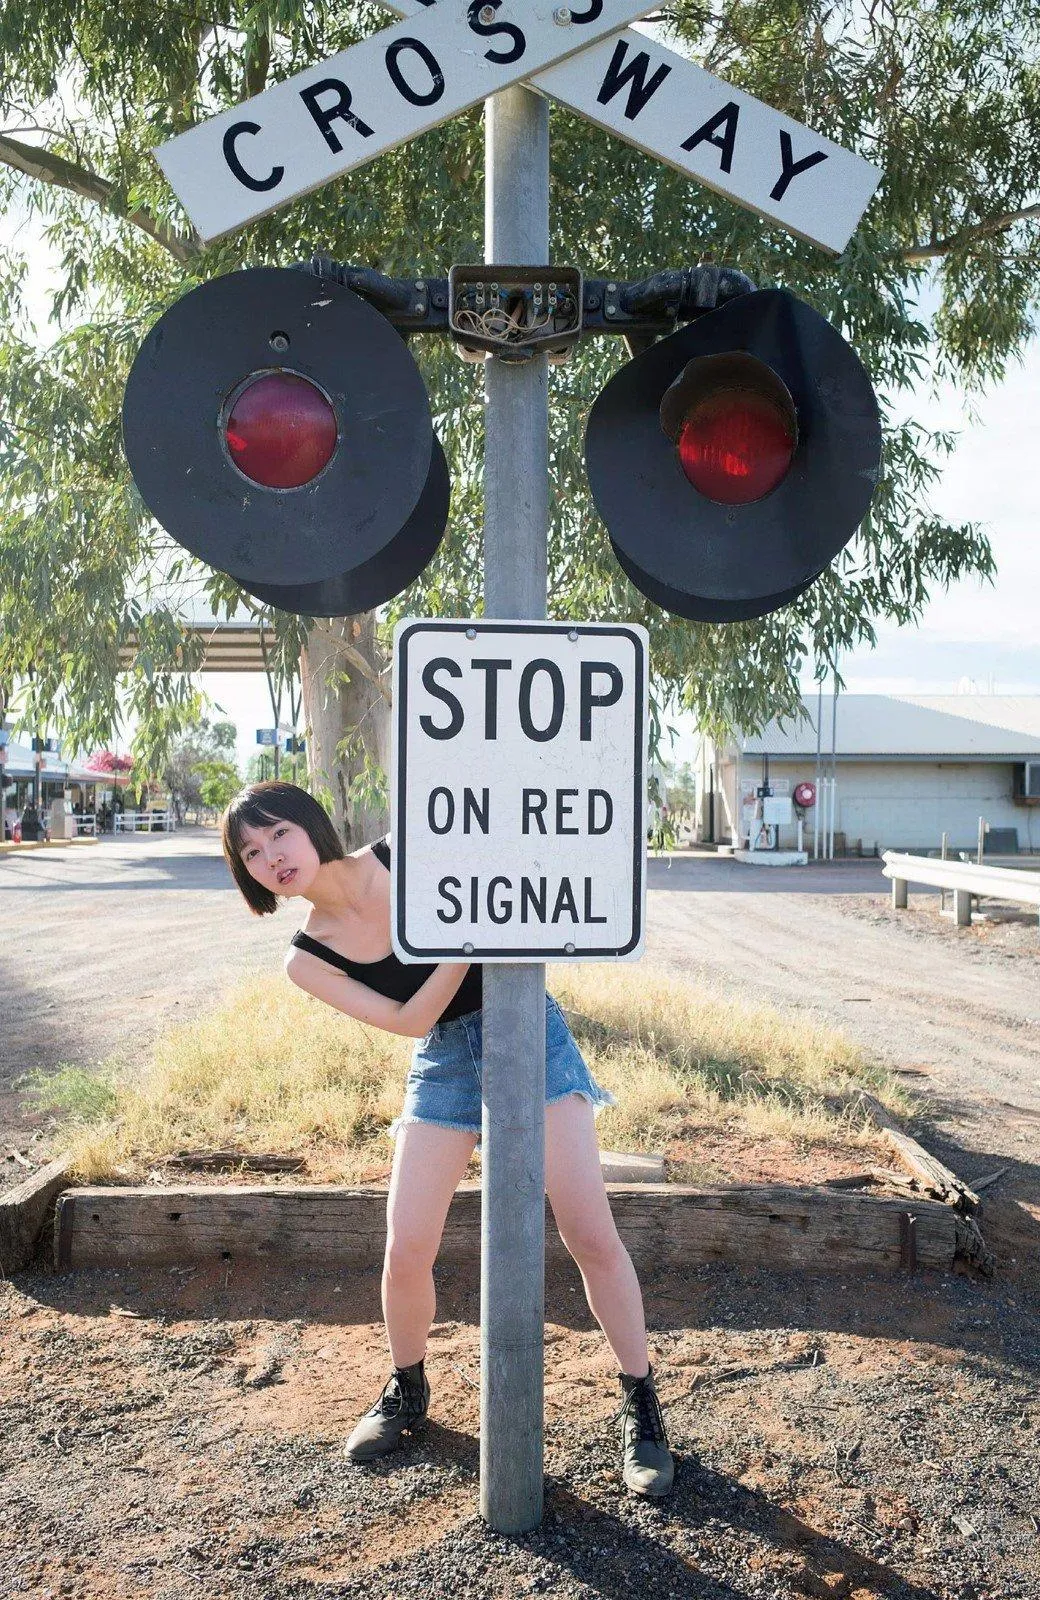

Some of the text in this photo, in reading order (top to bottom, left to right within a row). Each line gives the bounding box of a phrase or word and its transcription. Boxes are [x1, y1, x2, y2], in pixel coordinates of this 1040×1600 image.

[596, 38, 829, 203] WAY
[419, 656, 625, 743] STOP
[427, 786, 614, 835] ON RED
[436, 875, 608, 925] SIGNAL
